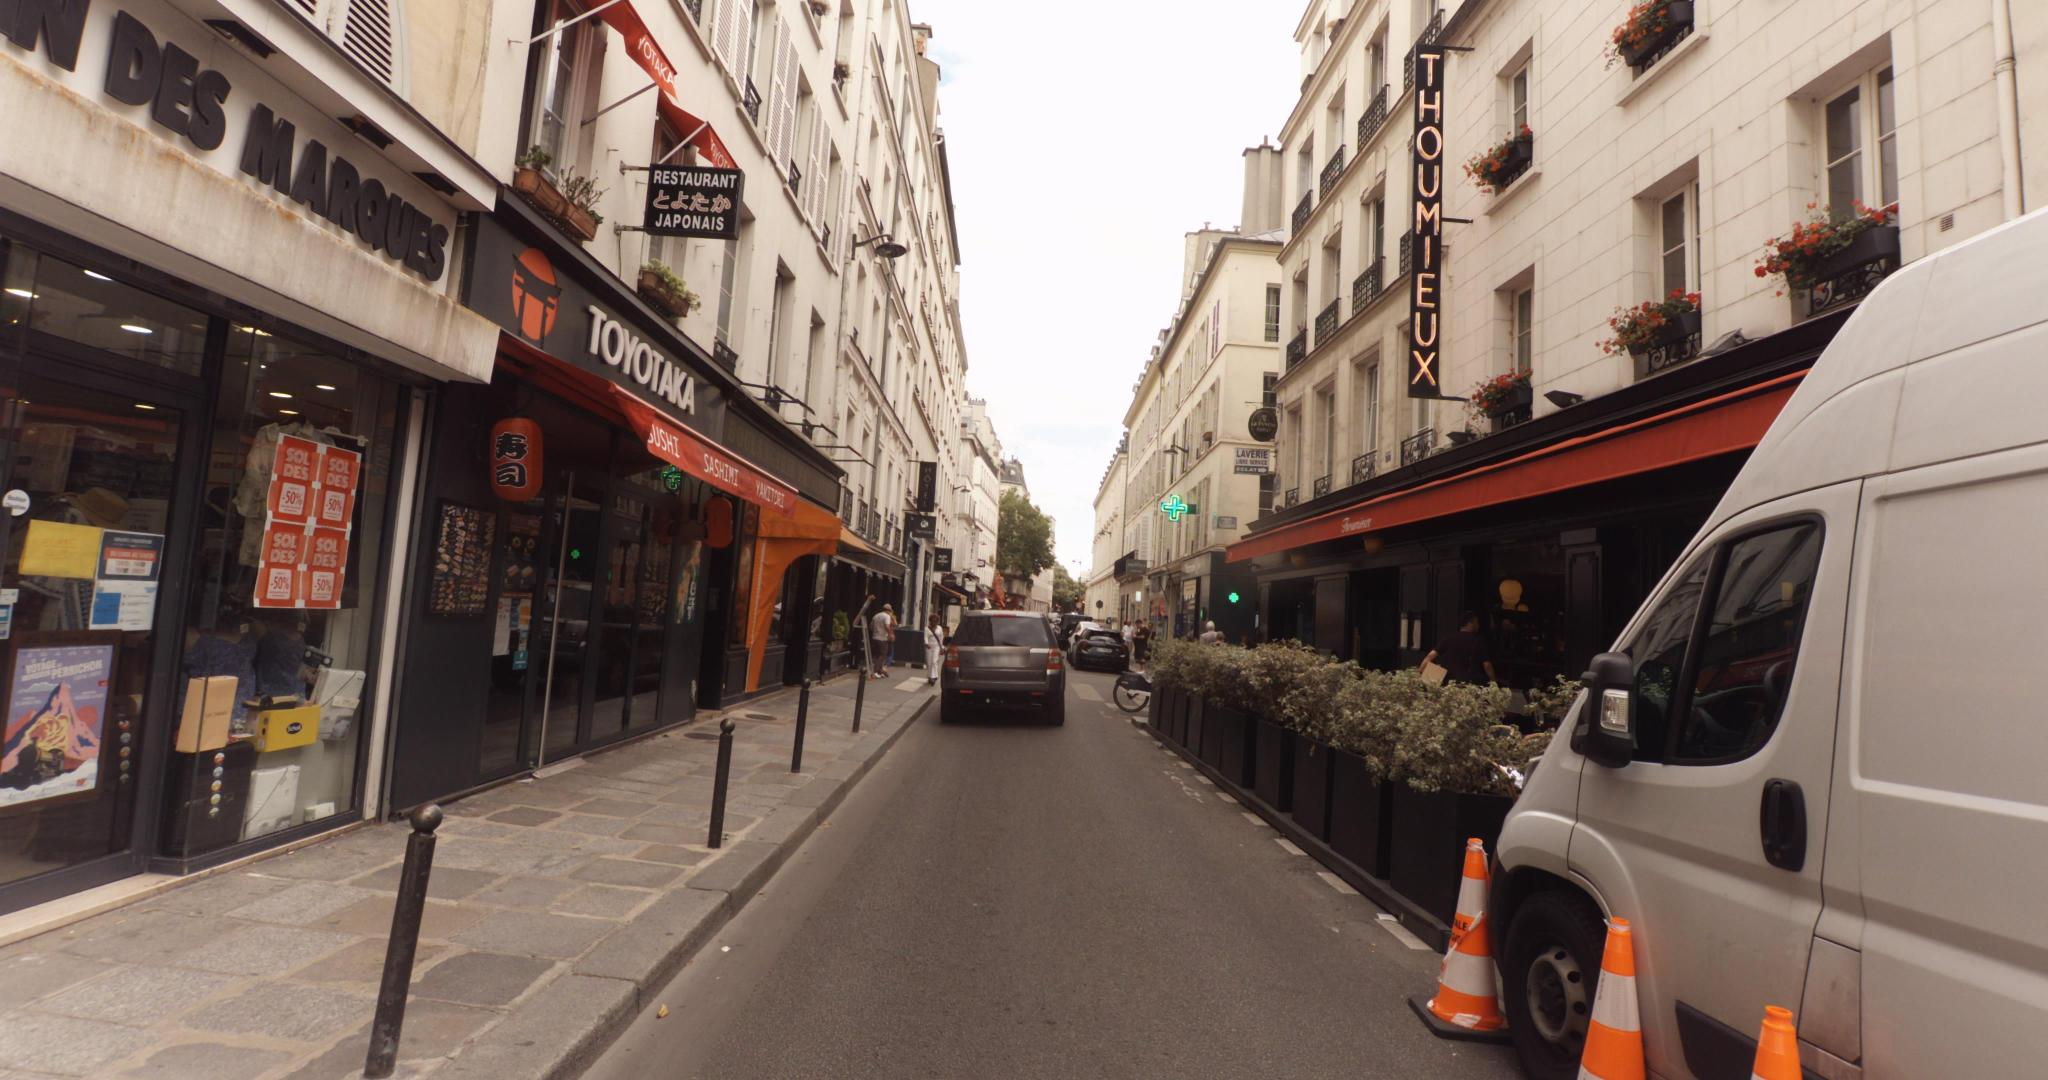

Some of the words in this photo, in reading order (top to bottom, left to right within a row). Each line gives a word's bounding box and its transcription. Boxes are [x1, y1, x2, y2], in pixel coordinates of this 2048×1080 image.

[104, 10, 232, 151] DES
[240, 103, 450, 282] MARQUES
[653, 170, 737, 189] RESTAURANT
[653, 189, 732, 214] とよたか
[655, 213, 724, 231] JAPONAIS
[1411, 53, 1443, 387] THOUMIEUX
[588, 304, 695, 415] TOYOTAKA
[287, 448, 310, 466] SOL
[495, 431, 529, 489] 寿司
[1236, 447, 1269, 459] LAVERIE
[283, 464, 310, 480] DES
[329, 458, 350, 475] SOL
[326, 473, 349, 489] DES
[703, 453, 740, 487] SASHIMI
[756, 479, 785, 509] YAKITORI
[282, 490, 303, 506] -50%
[273, 533, 298, 549] SOL
[317, 538, 338, 553] SOL
[271, 549, 297, 565] DES
[313, 554, 338, 568] DES
